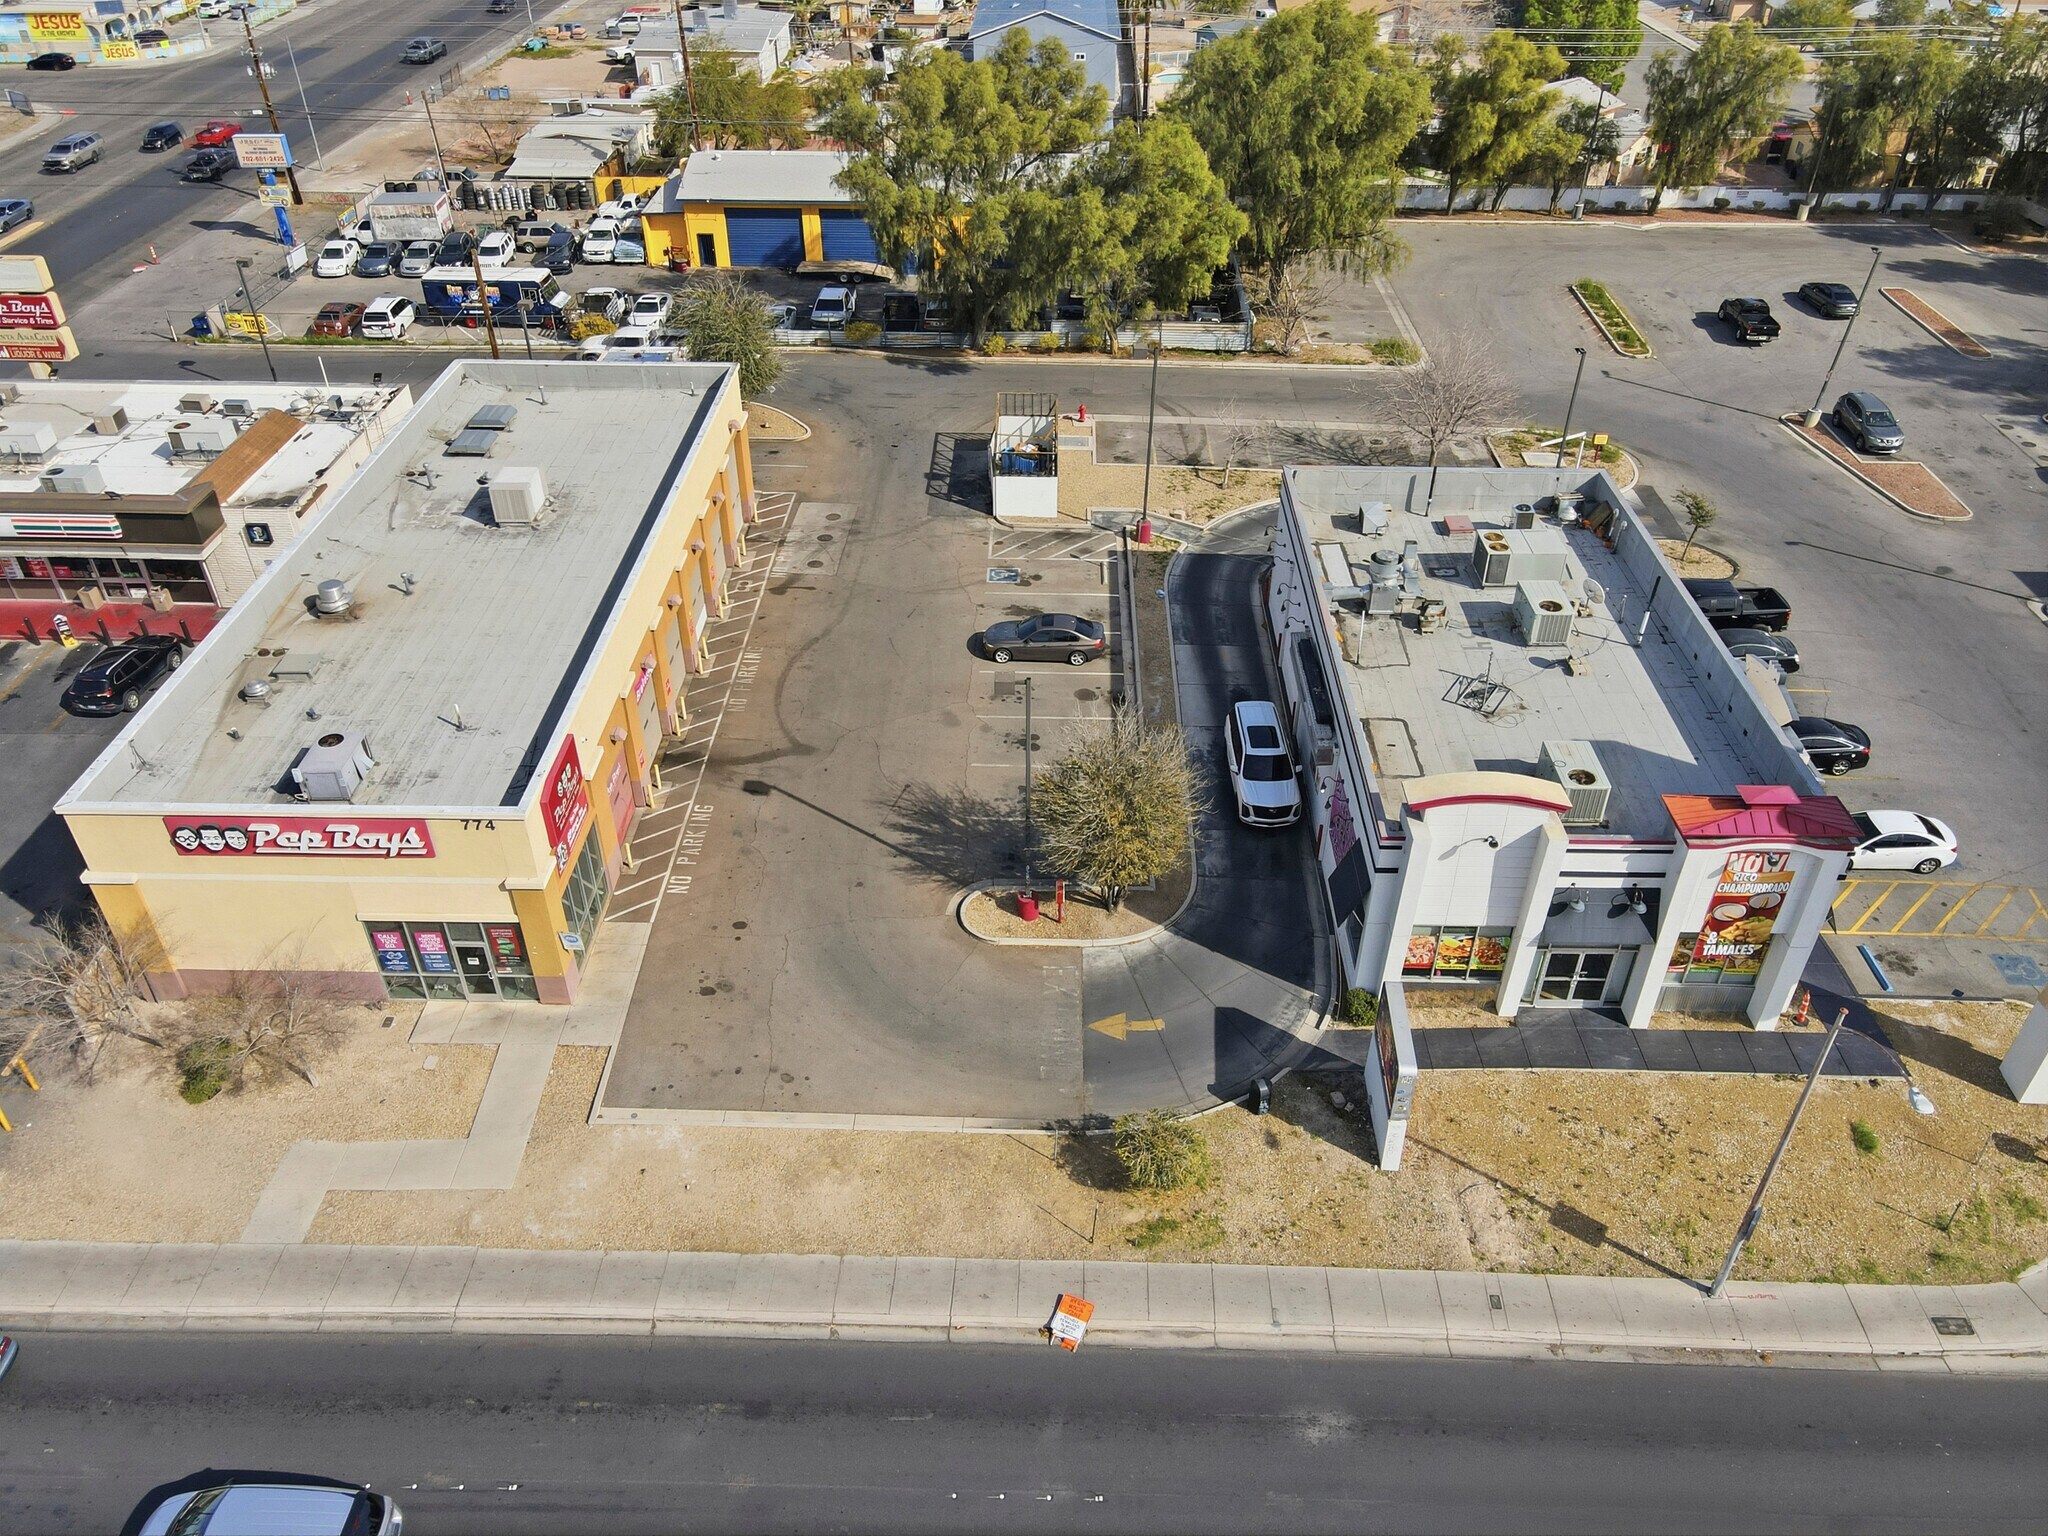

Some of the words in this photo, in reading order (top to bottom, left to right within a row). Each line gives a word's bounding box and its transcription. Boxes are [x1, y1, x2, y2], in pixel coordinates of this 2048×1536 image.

[32, 14, 81, 29] JESUS
[106, 47, 135, 58] JESUS
[8, 300, 50, 316] Boys
[733, 646, 764, 690] PARKING
[727, 698, 747, 712] NO
[460, 819, 495, 830] 774
[247, 823, 328, 851] Pep
[325, 824, 425, 857] Boys
[677, 803, 714, 864] PARKING
[1727, 853, 1789, 873] NOW
[667, 874, 692, 895] NO
[1733, 873, 1758, 882] RICO
[1706, 931, 1718, 944] &
[1702, 944, 1755, 956] TAMALES
